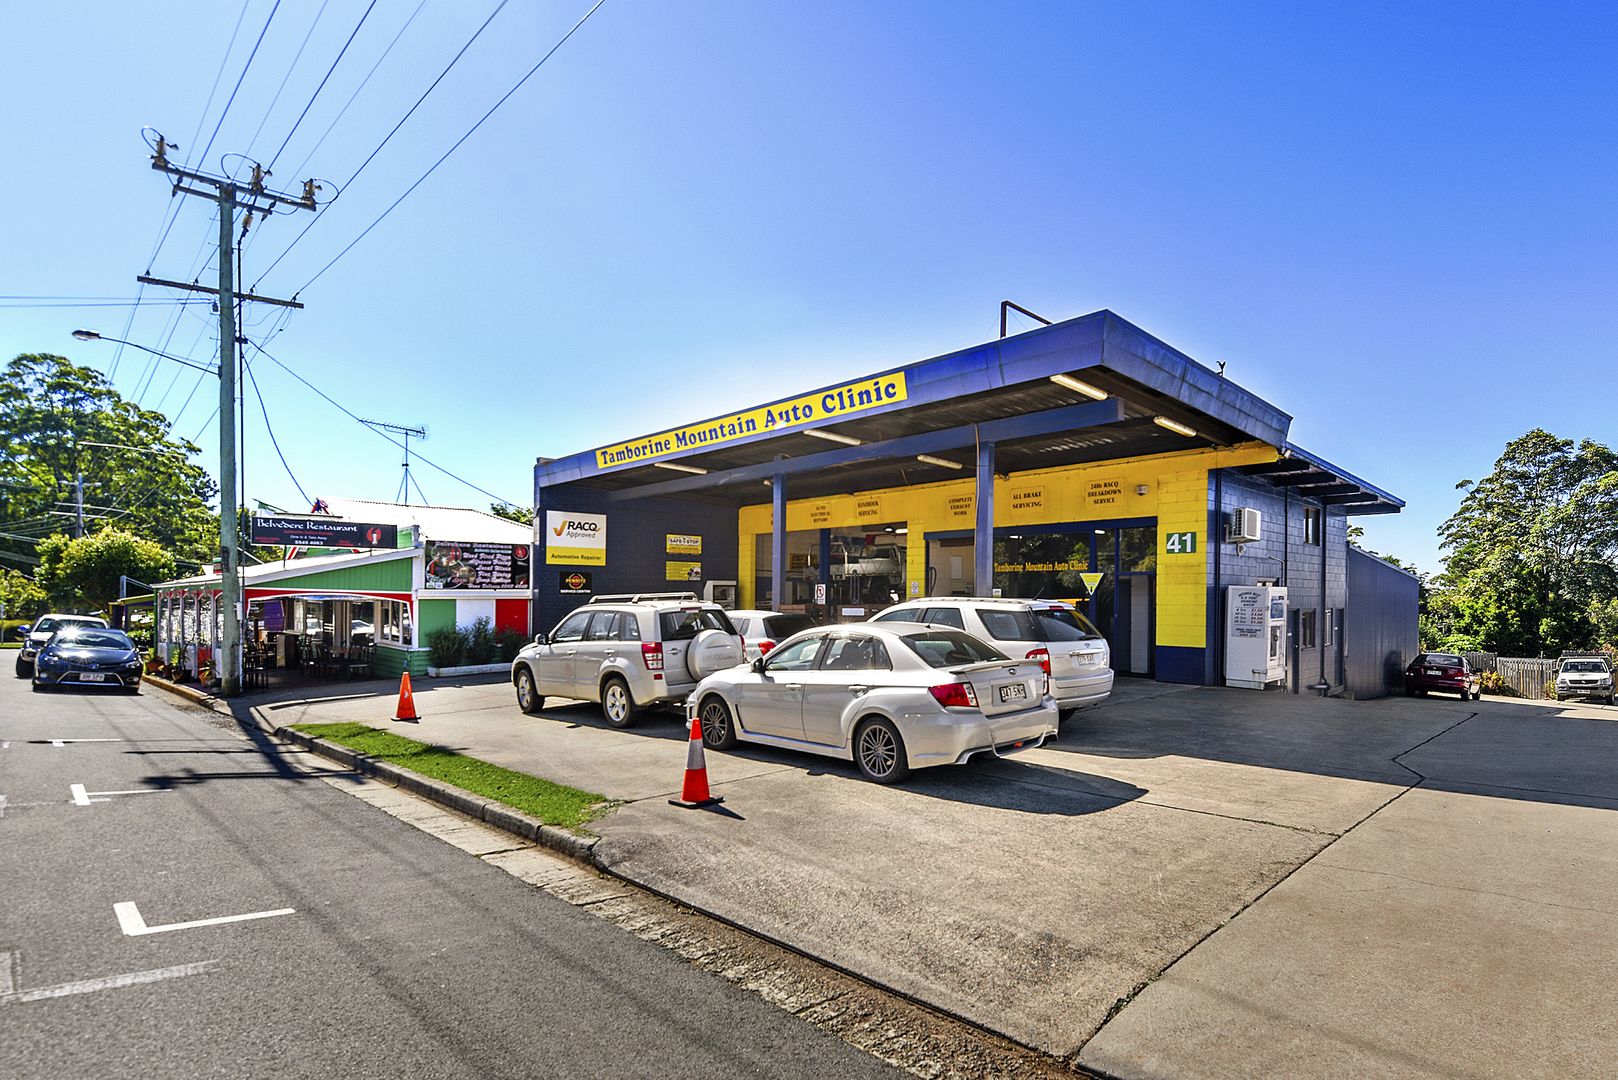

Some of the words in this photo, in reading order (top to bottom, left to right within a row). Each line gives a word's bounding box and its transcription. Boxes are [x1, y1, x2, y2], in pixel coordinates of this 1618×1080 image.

[600, 435, 671, 465] Tamborine
[676, 416, 757, 446] Mountain
[764, 403, 813, 428] Auto
[821, 381, 898, 414] Clinic
[1023, 491, 1042, 499] BRAKE
[1088, 489, 1121, 497] BREAKDOWN
[1012, 501, 1042, 509] SERVICING
[257, 519, 304, 529] Belvedere
[306, 521, 358, 532] Restaurant
[567, 521, 598, 532] RACQ
[566, 531, 596, 539] Approved
[1166, 532, 1192, 553] 41
[994, 562, 1024, 573] Tamborine
[1025, 561, 1053, 573] Mountain
[1054, 561, 1069, 571] Auto
[1069, 560, 1089, 571] Clinic
